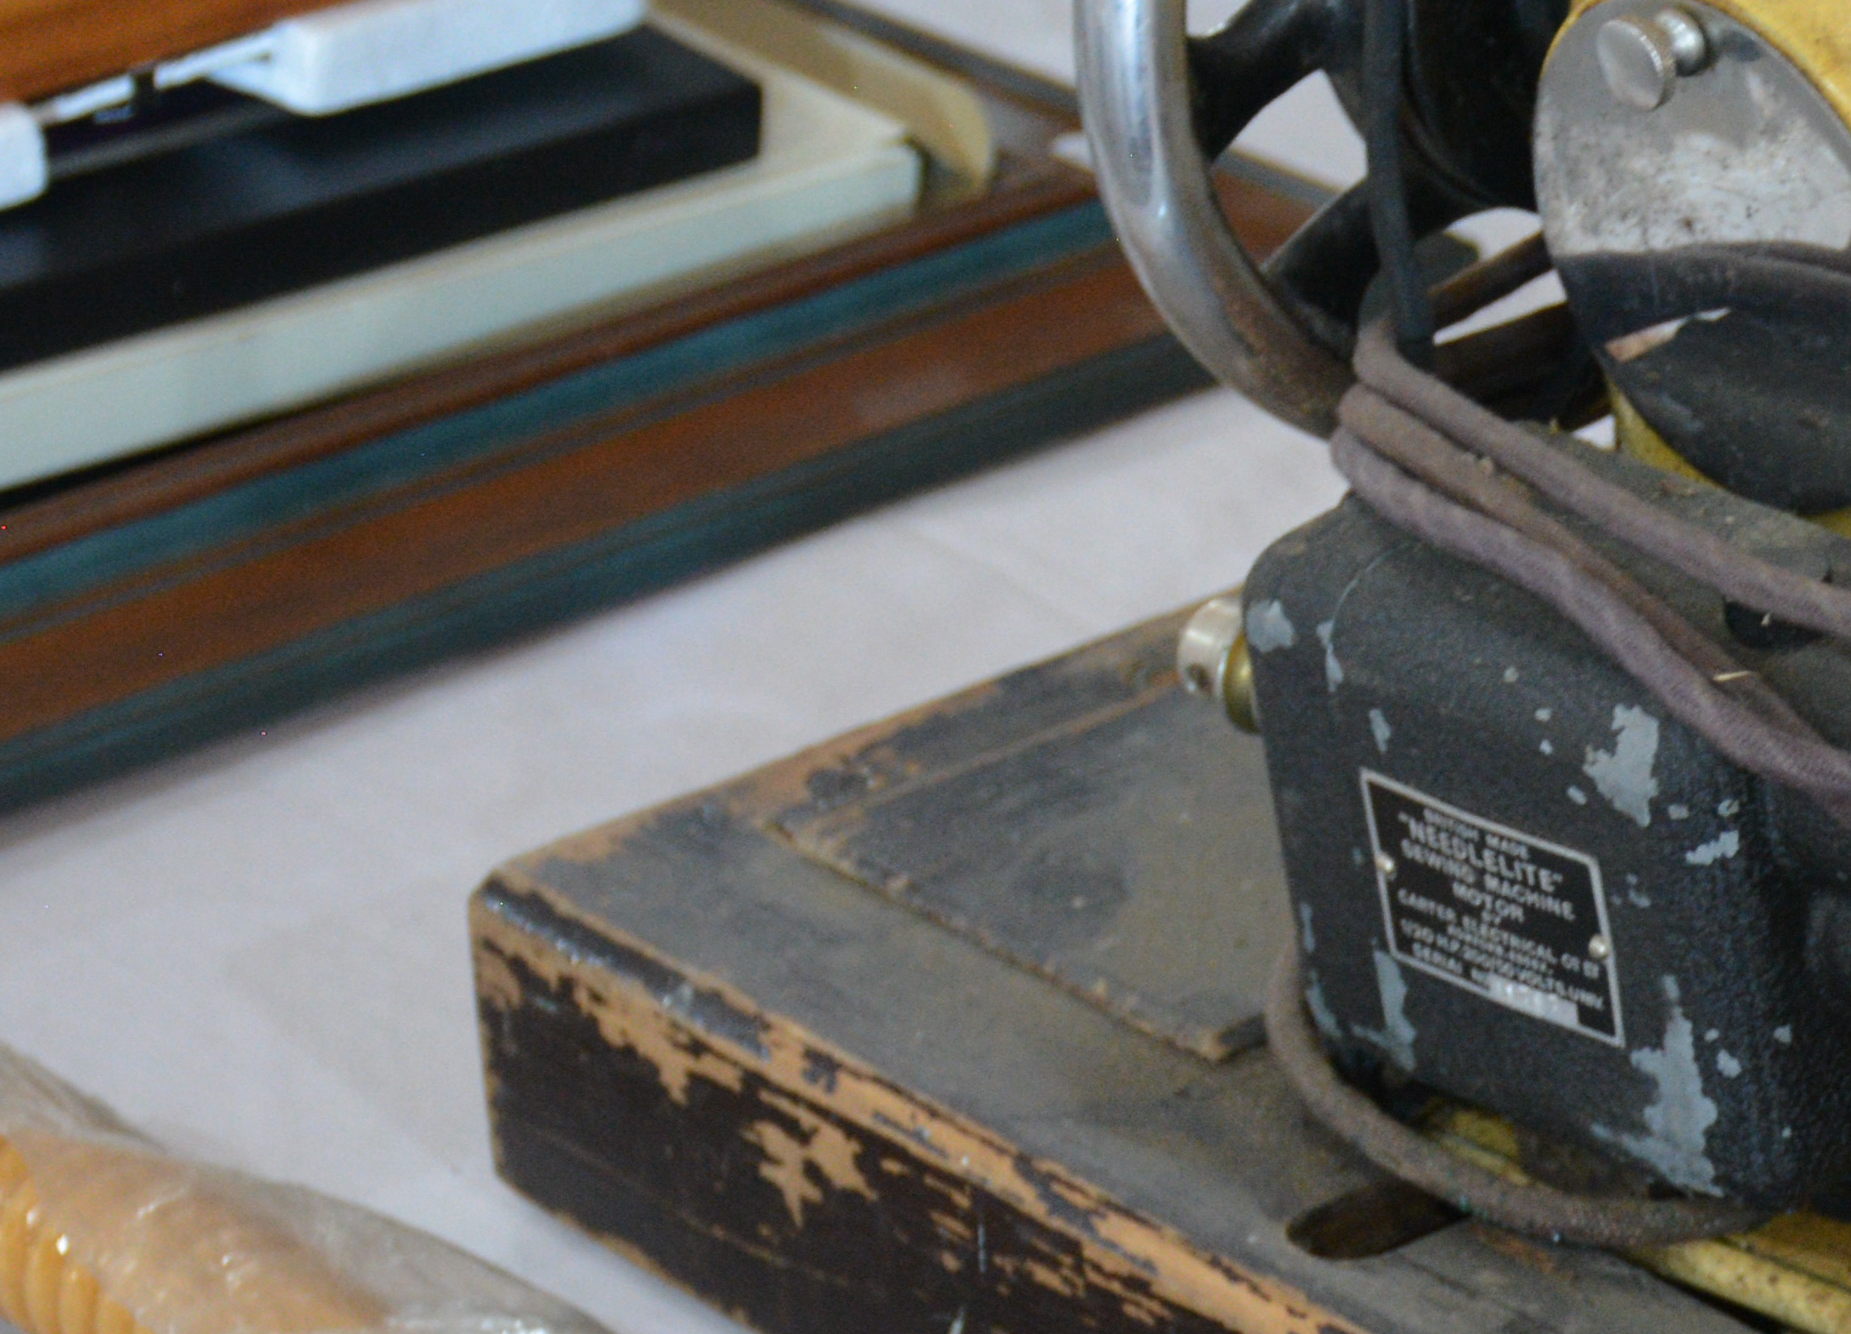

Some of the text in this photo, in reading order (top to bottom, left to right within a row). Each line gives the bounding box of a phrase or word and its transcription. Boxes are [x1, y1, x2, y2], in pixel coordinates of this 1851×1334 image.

[1401, 838, 1576, 922] SEWING MACHINE
[1452, 881, 1525, 924] MOTOR
